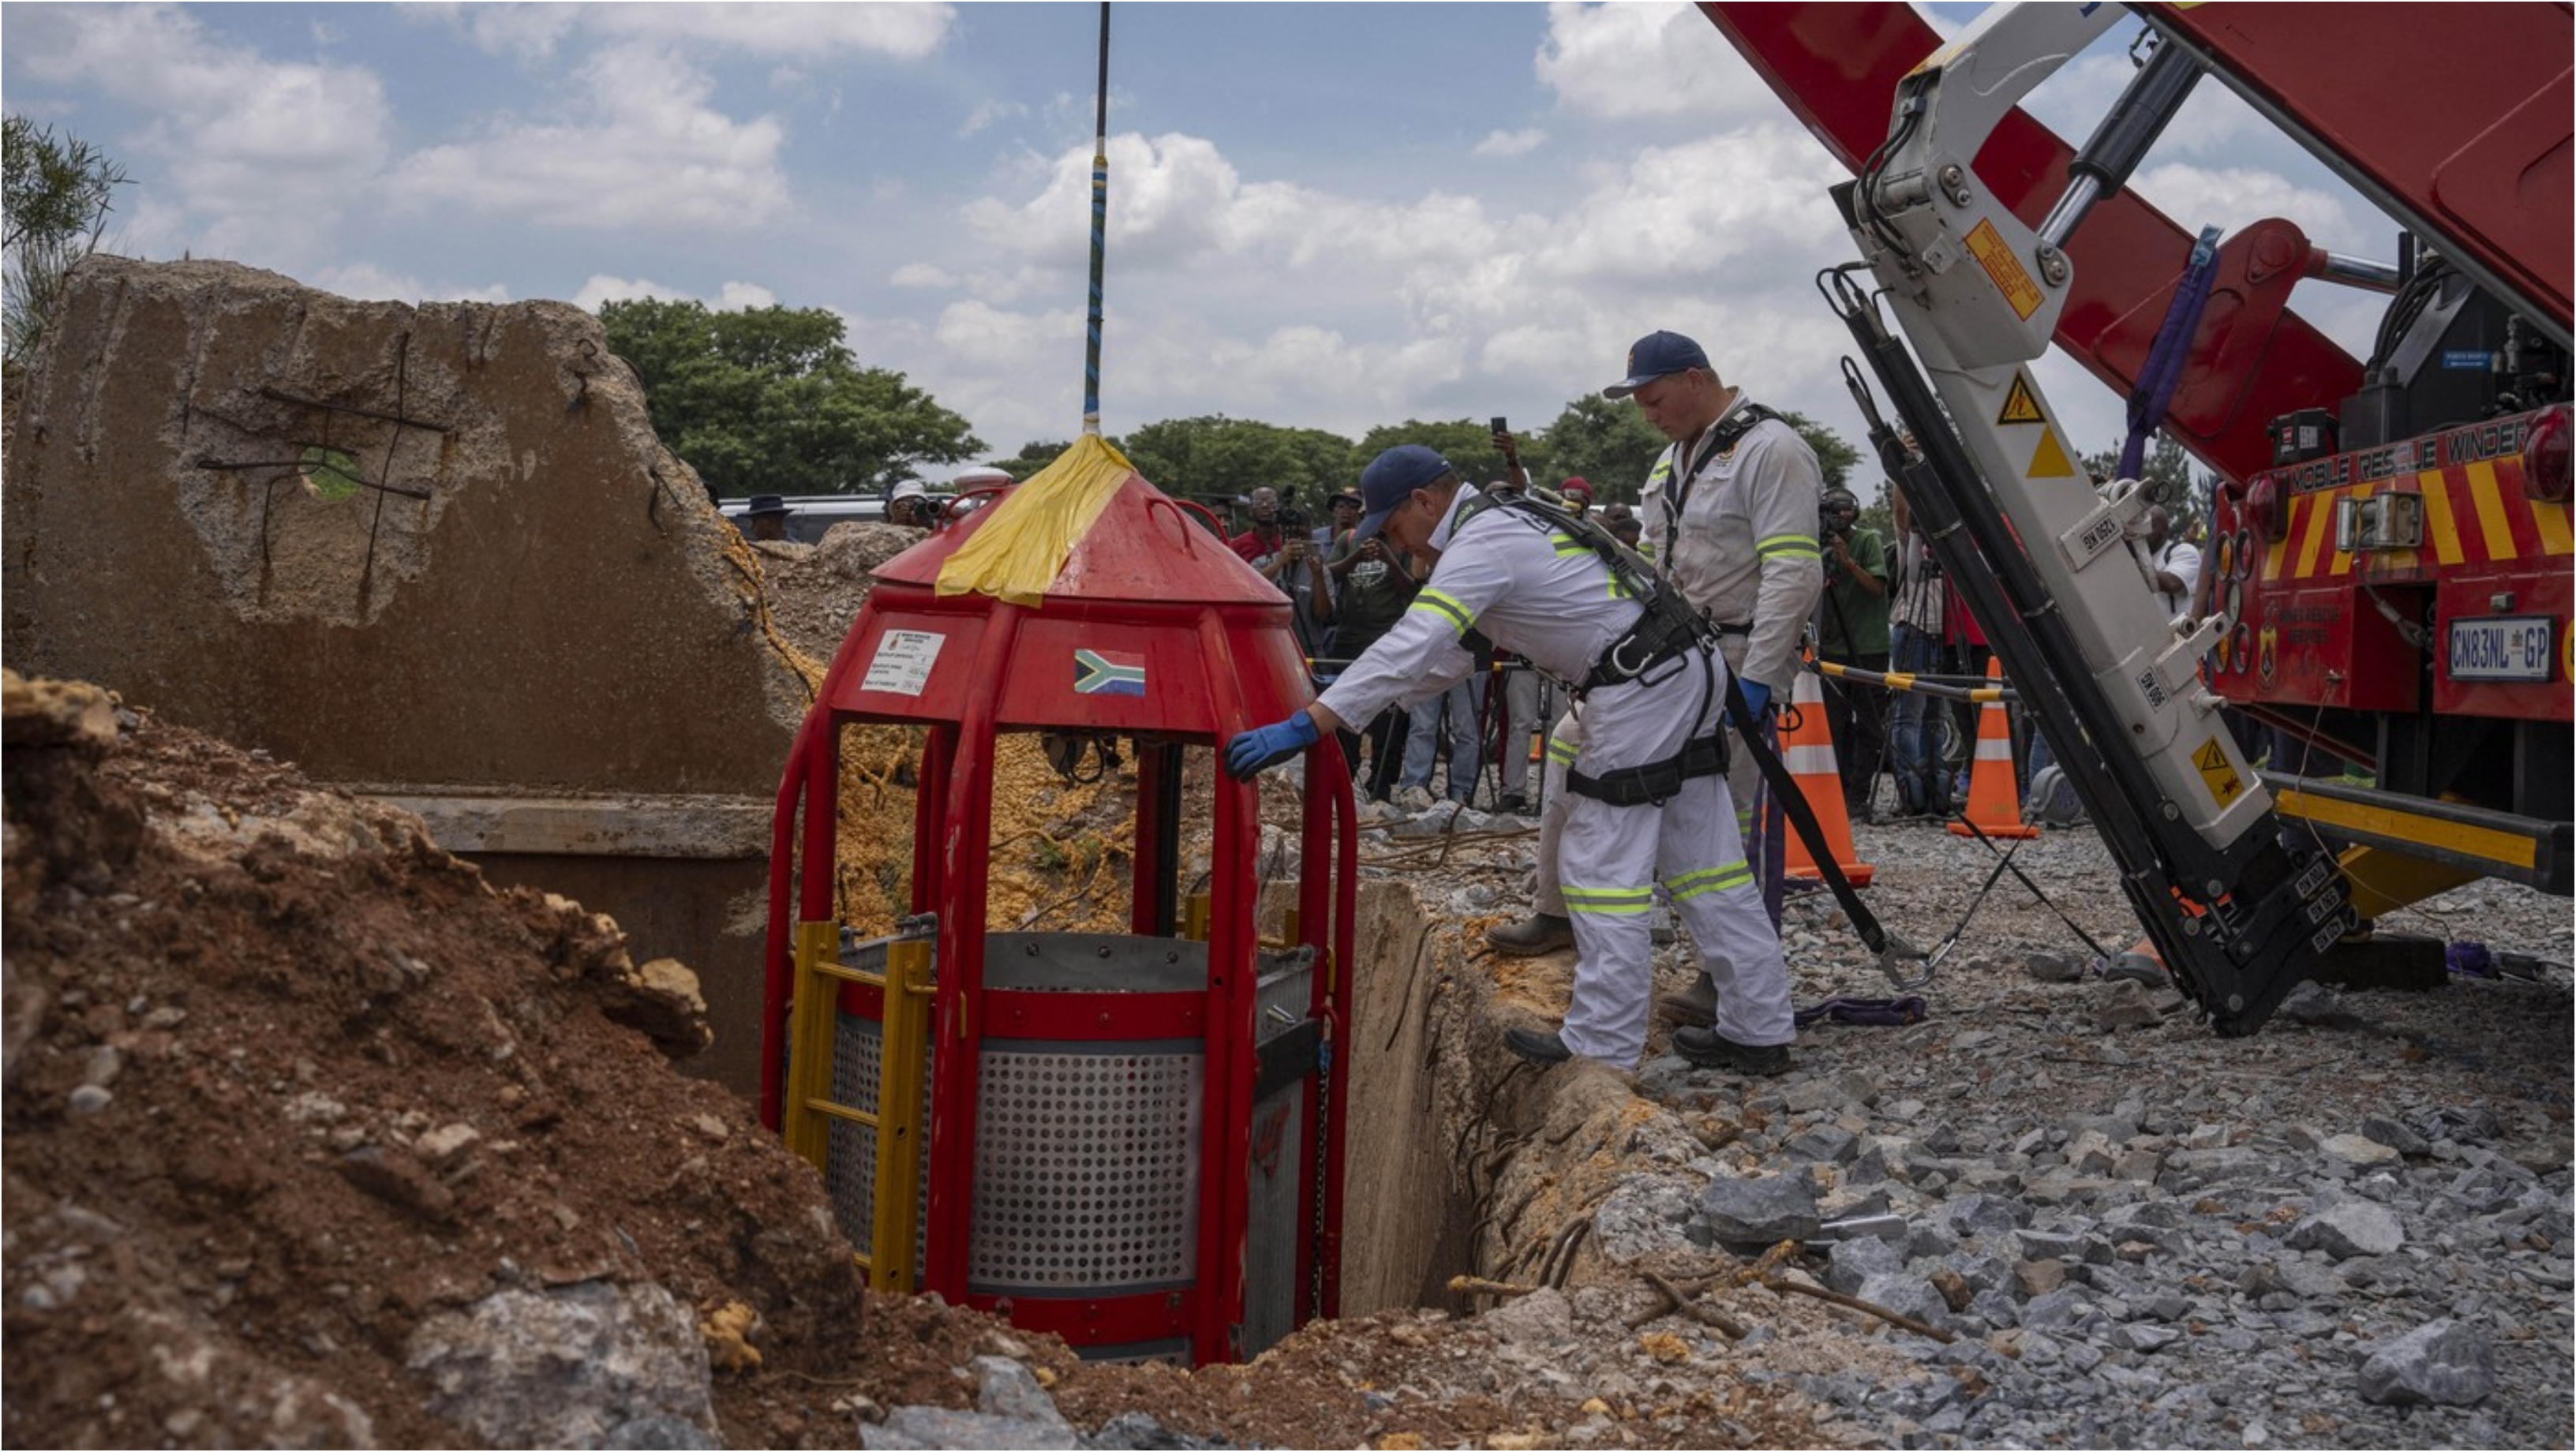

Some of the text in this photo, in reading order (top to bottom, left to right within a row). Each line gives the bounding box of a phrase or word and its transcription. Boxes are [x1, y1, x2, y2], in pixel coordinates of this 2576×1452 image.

[2292, 420, 2525, 490] MOBILE RESCUE WINDER
[2084, 517, 2116, 550] 1250 KG
[2452, 627, 2510, 669] CN83NL
[2525, 627, 2548, 669] GP
[2140, 672, 2155, 691] KG
